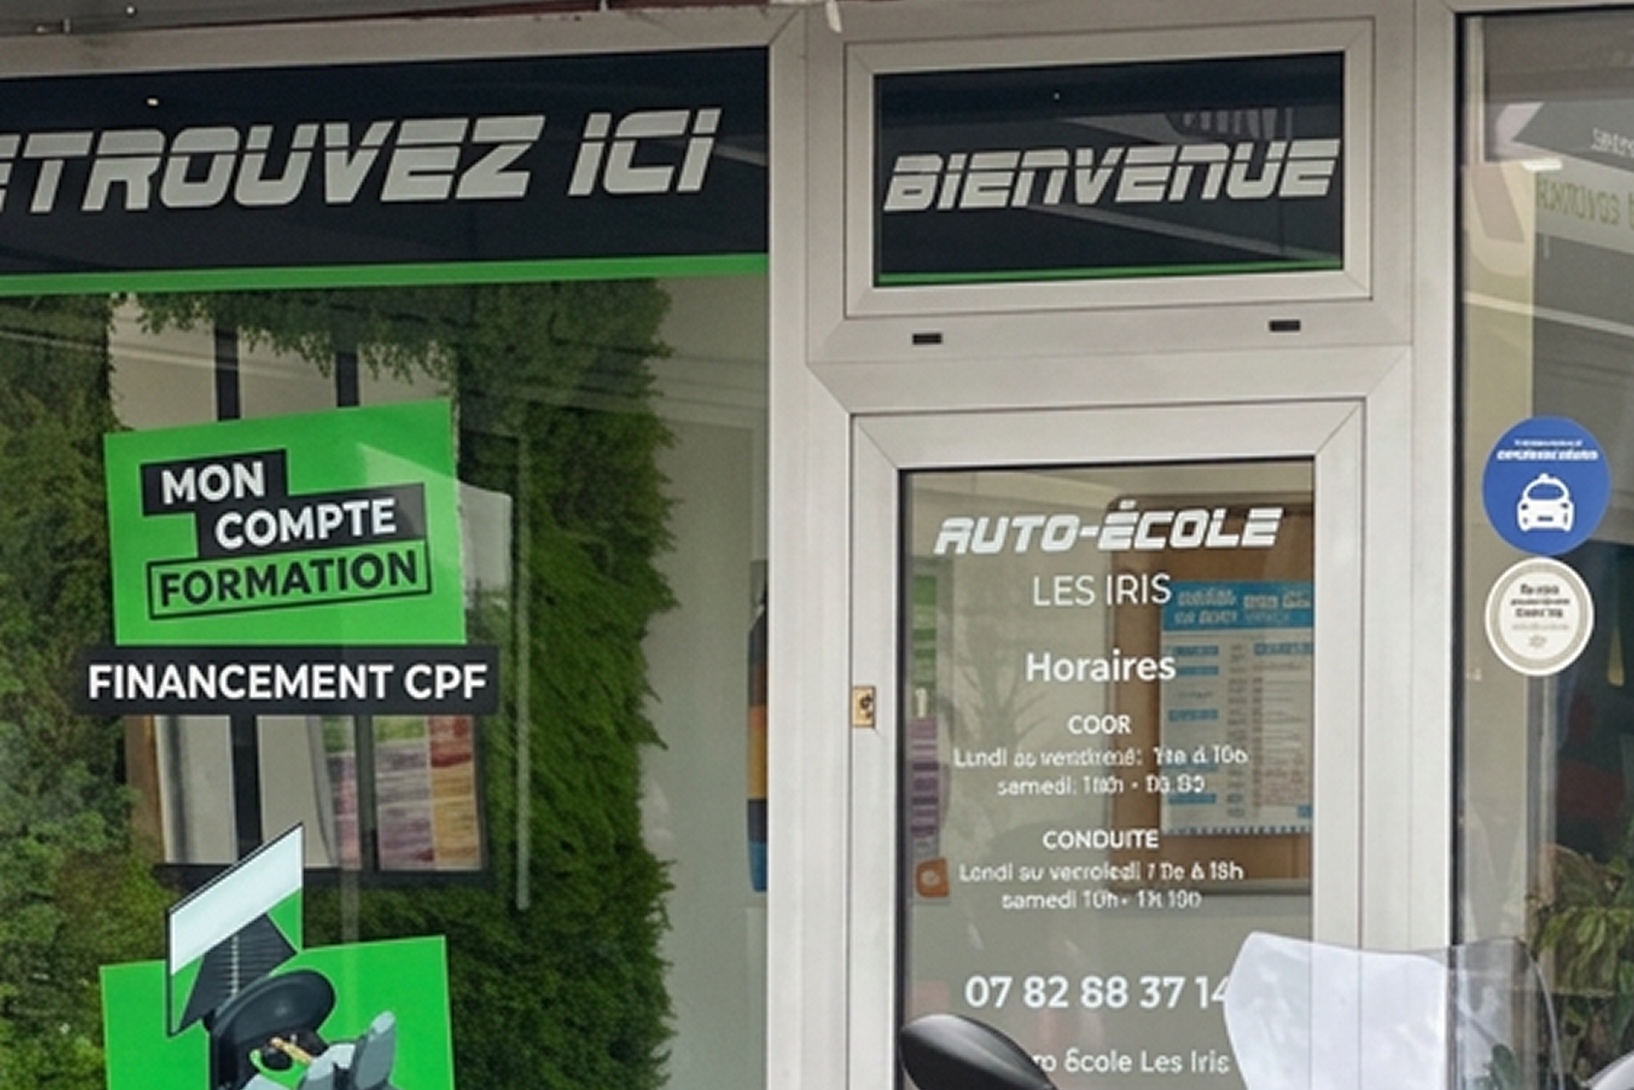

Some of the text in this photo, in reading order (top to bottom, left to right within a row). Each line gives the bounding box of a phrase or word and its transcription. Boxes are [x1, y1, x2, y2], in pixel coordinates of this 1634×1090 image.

[568, 108, 722, 197] ICI
[883, 138, 1342, 212] BIENVENUE
[161, 461, 265, 507] MON
[214, 497, 397, 551] COMPTE
[934, 499, 1284, 556] AUTO-ÉCOLE
[160, 549, 418, 608] FORMATION
[1033, 575, 1096, 606] LES
[1106, 573, 1172, 605] IRIS
[87, 662, 489, 701] FINANCEMENT CPF
[1026, 649, 1177, 682] Horaires
[964, 975, 1014, 1008] 07
[1023, 975, 1069, 1008] 82
[1139, 975, 1186, 1008] 37
[1141, 1050, 1183, 1072] Les
